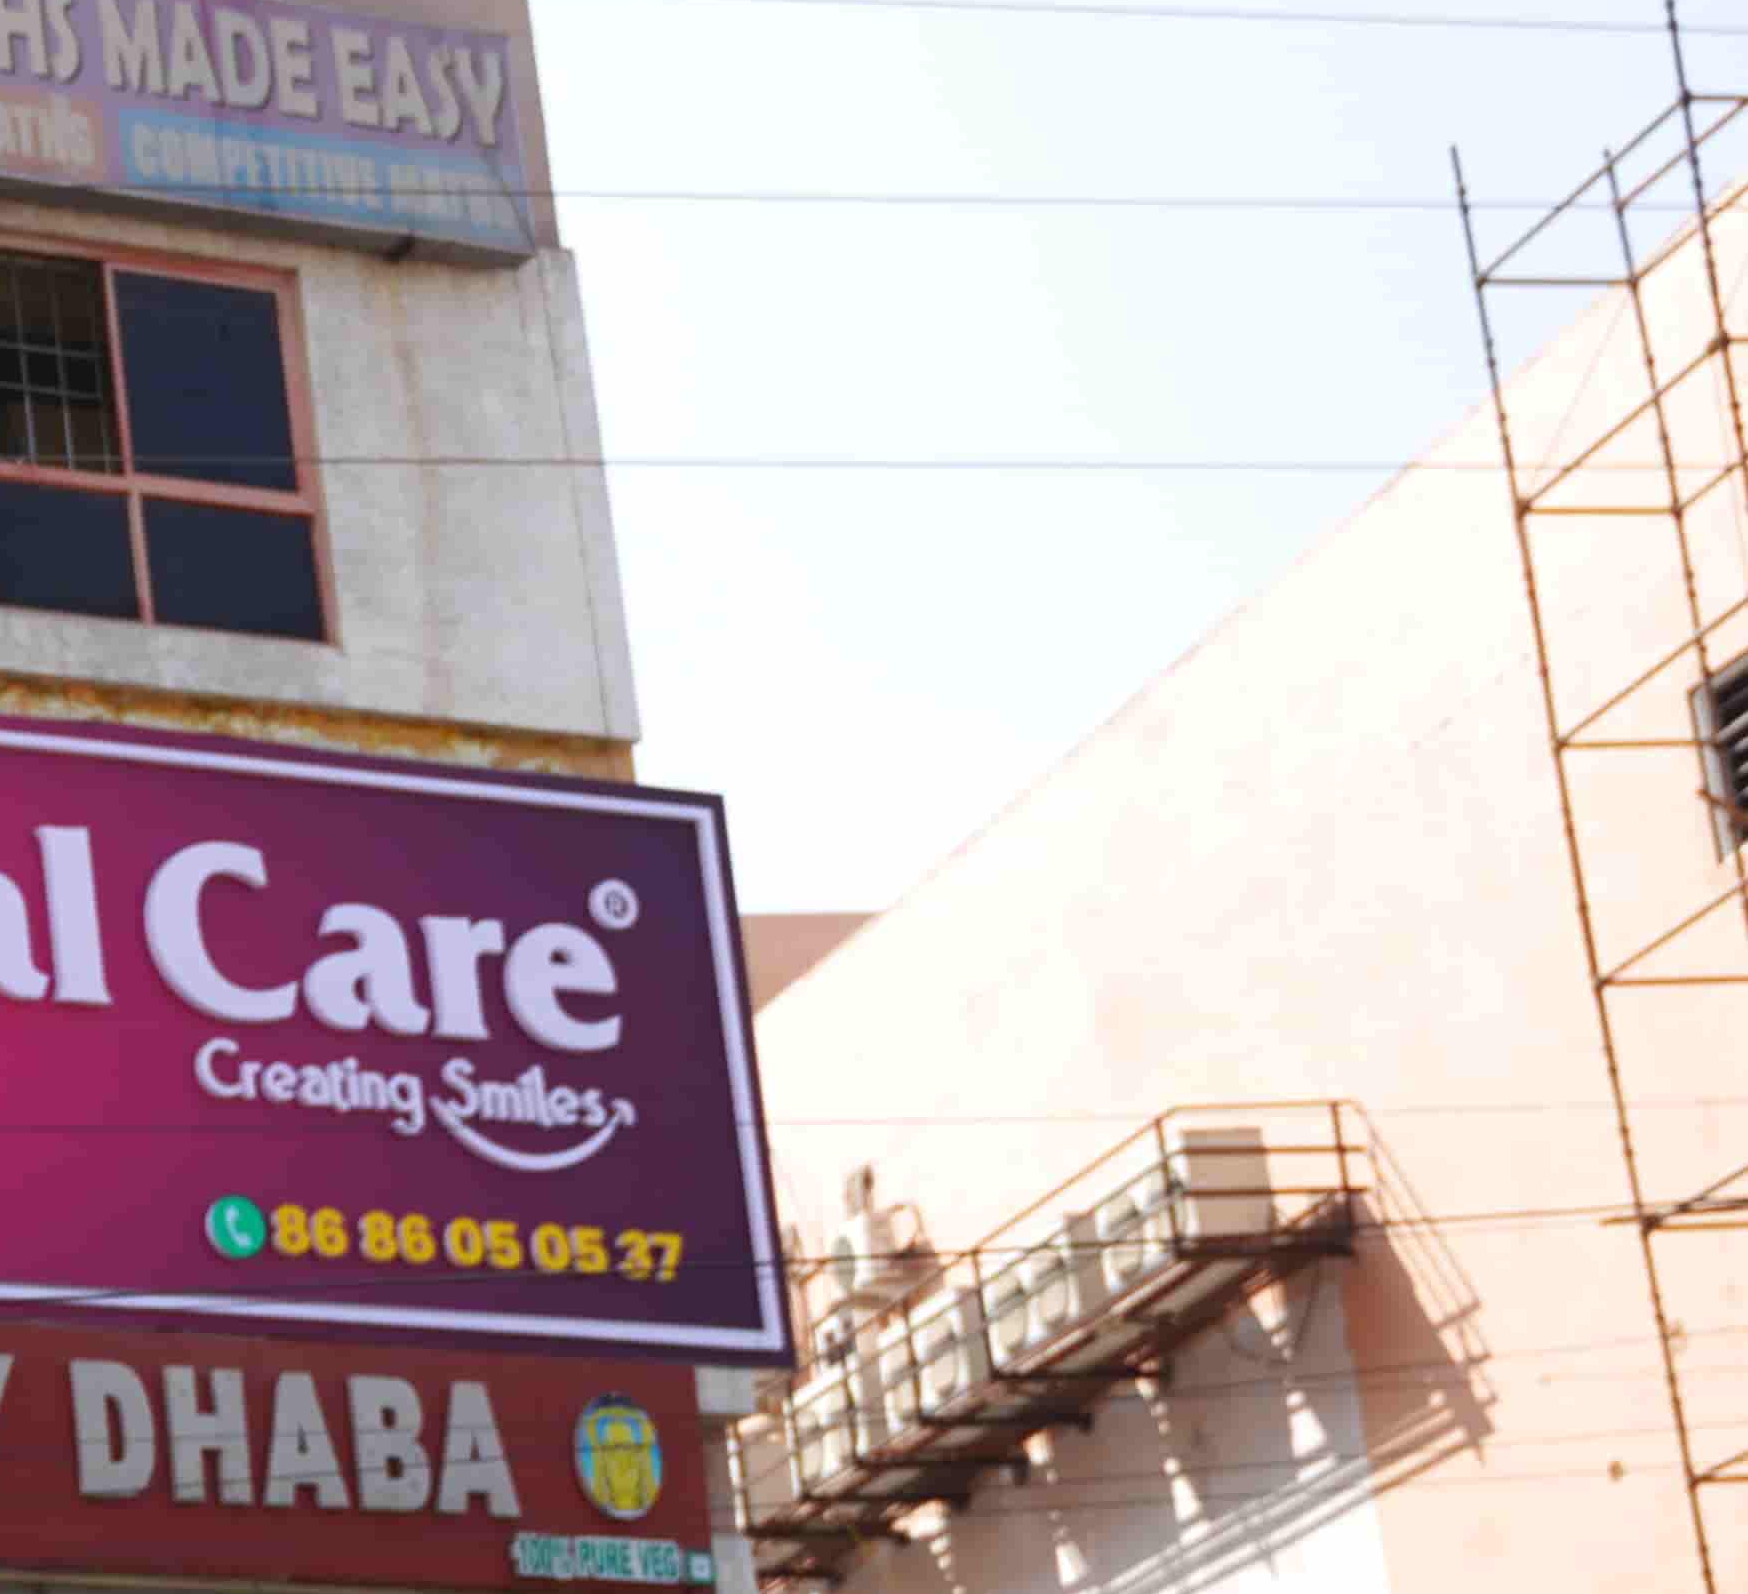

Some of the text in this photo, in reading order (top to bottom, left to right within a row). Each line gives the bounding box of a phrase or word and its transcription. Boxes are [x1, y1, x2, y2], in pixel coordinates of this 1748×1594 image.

[329, 15, 505, 149] EASY
[130, 120, 383, 209] COMPETITIVE
[143, 840, 622, 1052] Care
[194, 1037, 605, 1135] Creating Smiles
[68, 1357, 521, 1519] DHABA
